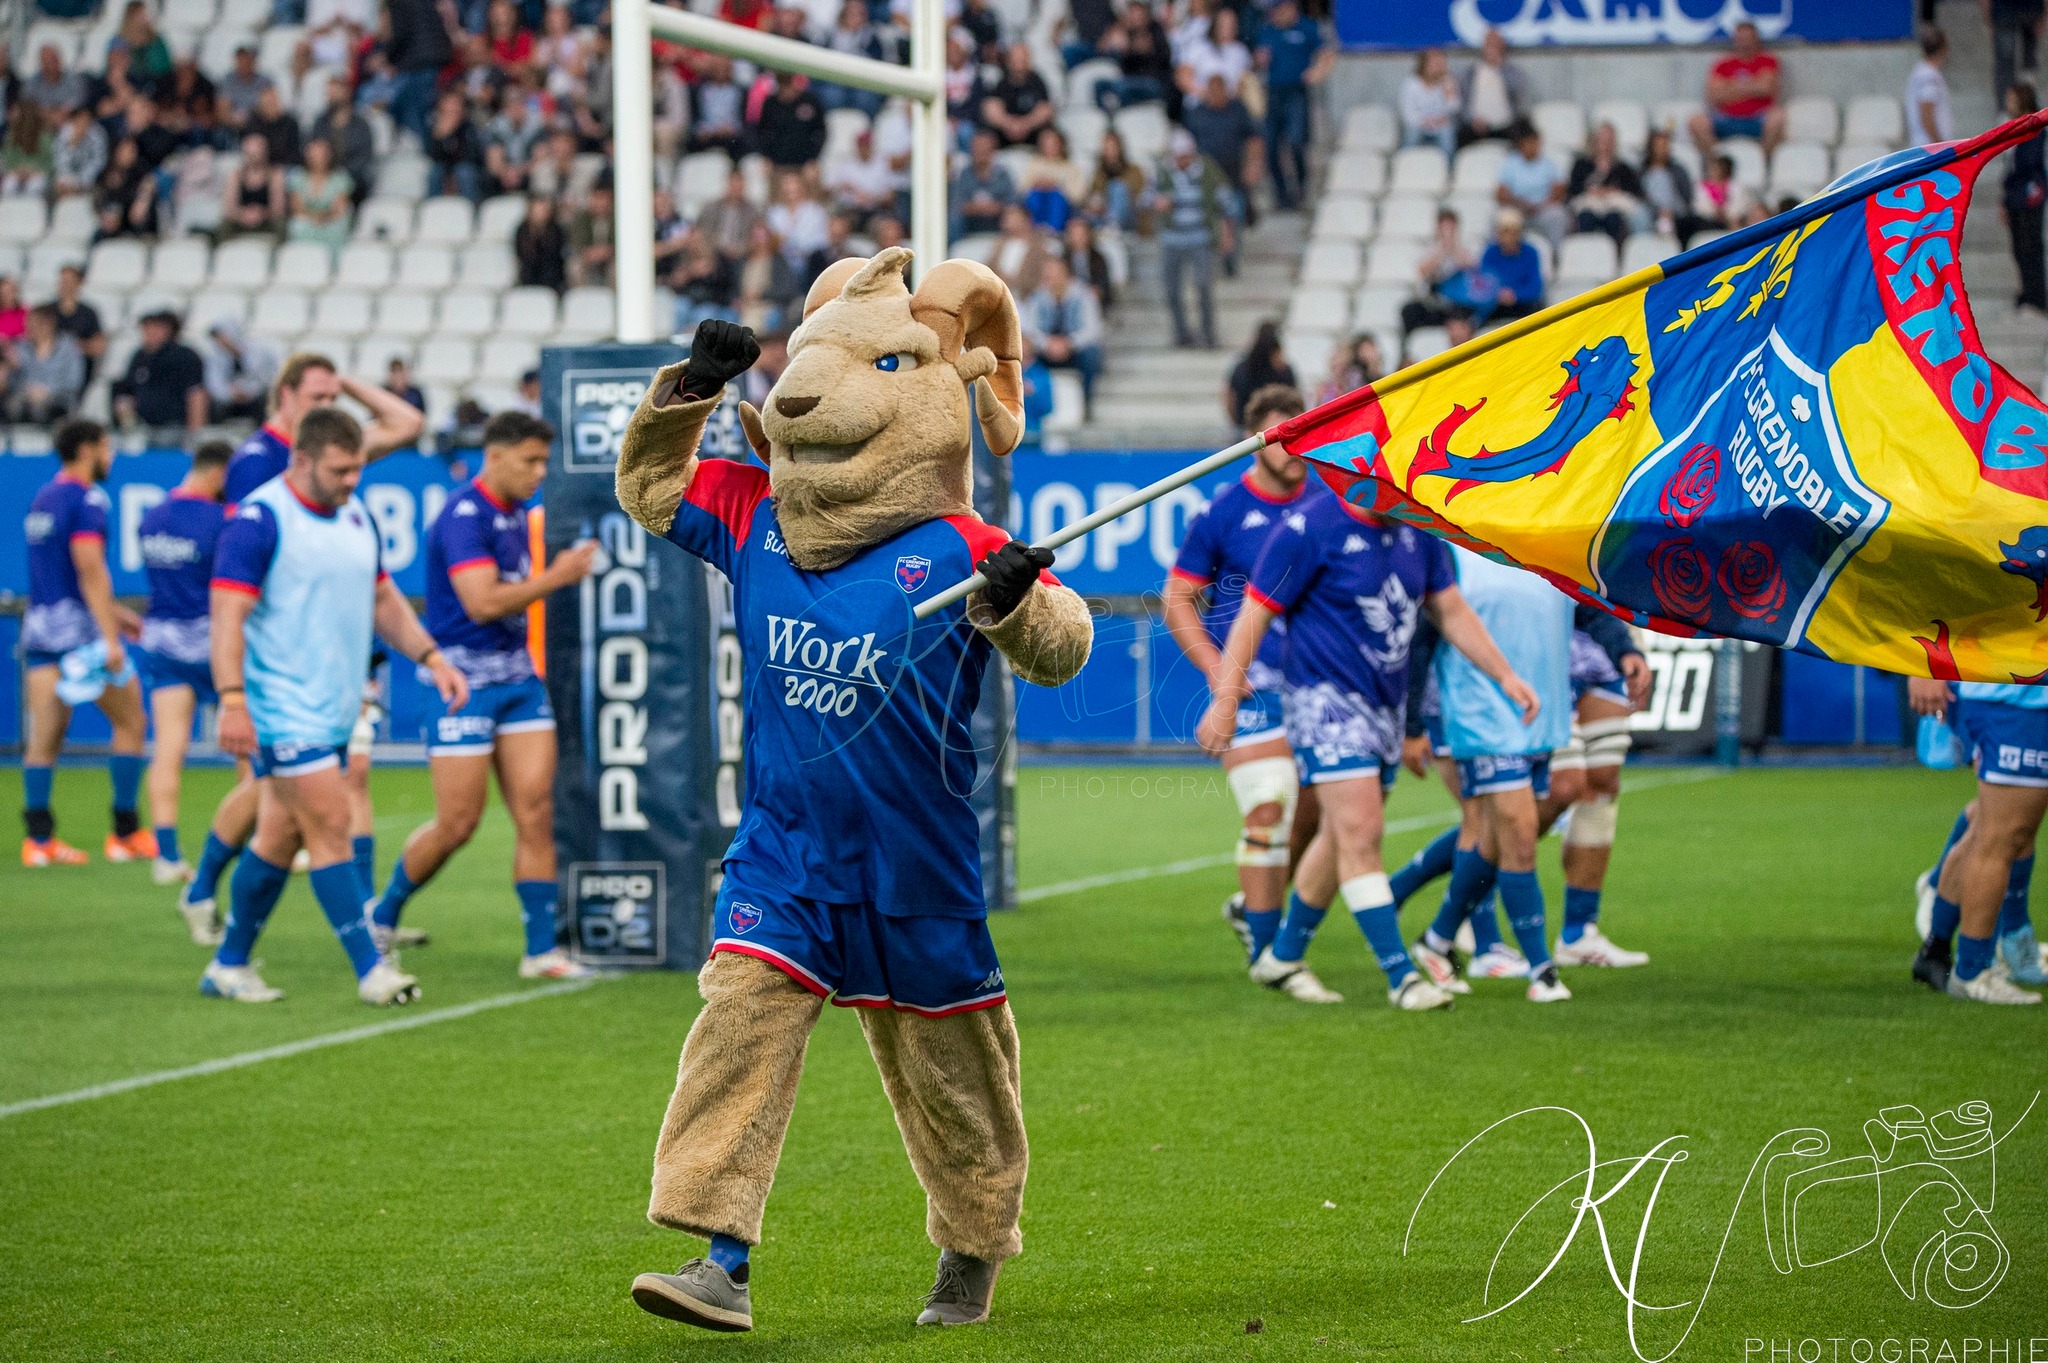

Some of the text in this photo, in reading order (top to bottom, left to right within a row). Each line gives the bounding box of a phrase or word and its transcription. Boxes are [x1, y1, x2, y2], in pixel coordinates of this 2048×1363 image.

[575, 382, 646, 406] PRO
[1728, 419, 1789, 520] RUGBY
[1747, 377, 1862, 535] GRENOBLE
[767, 615, 887, 692] Work
[785, 675, 857, 717] 2000
[581, 875, 653, 899] PRO
[581, 914, 653, 947] D2
